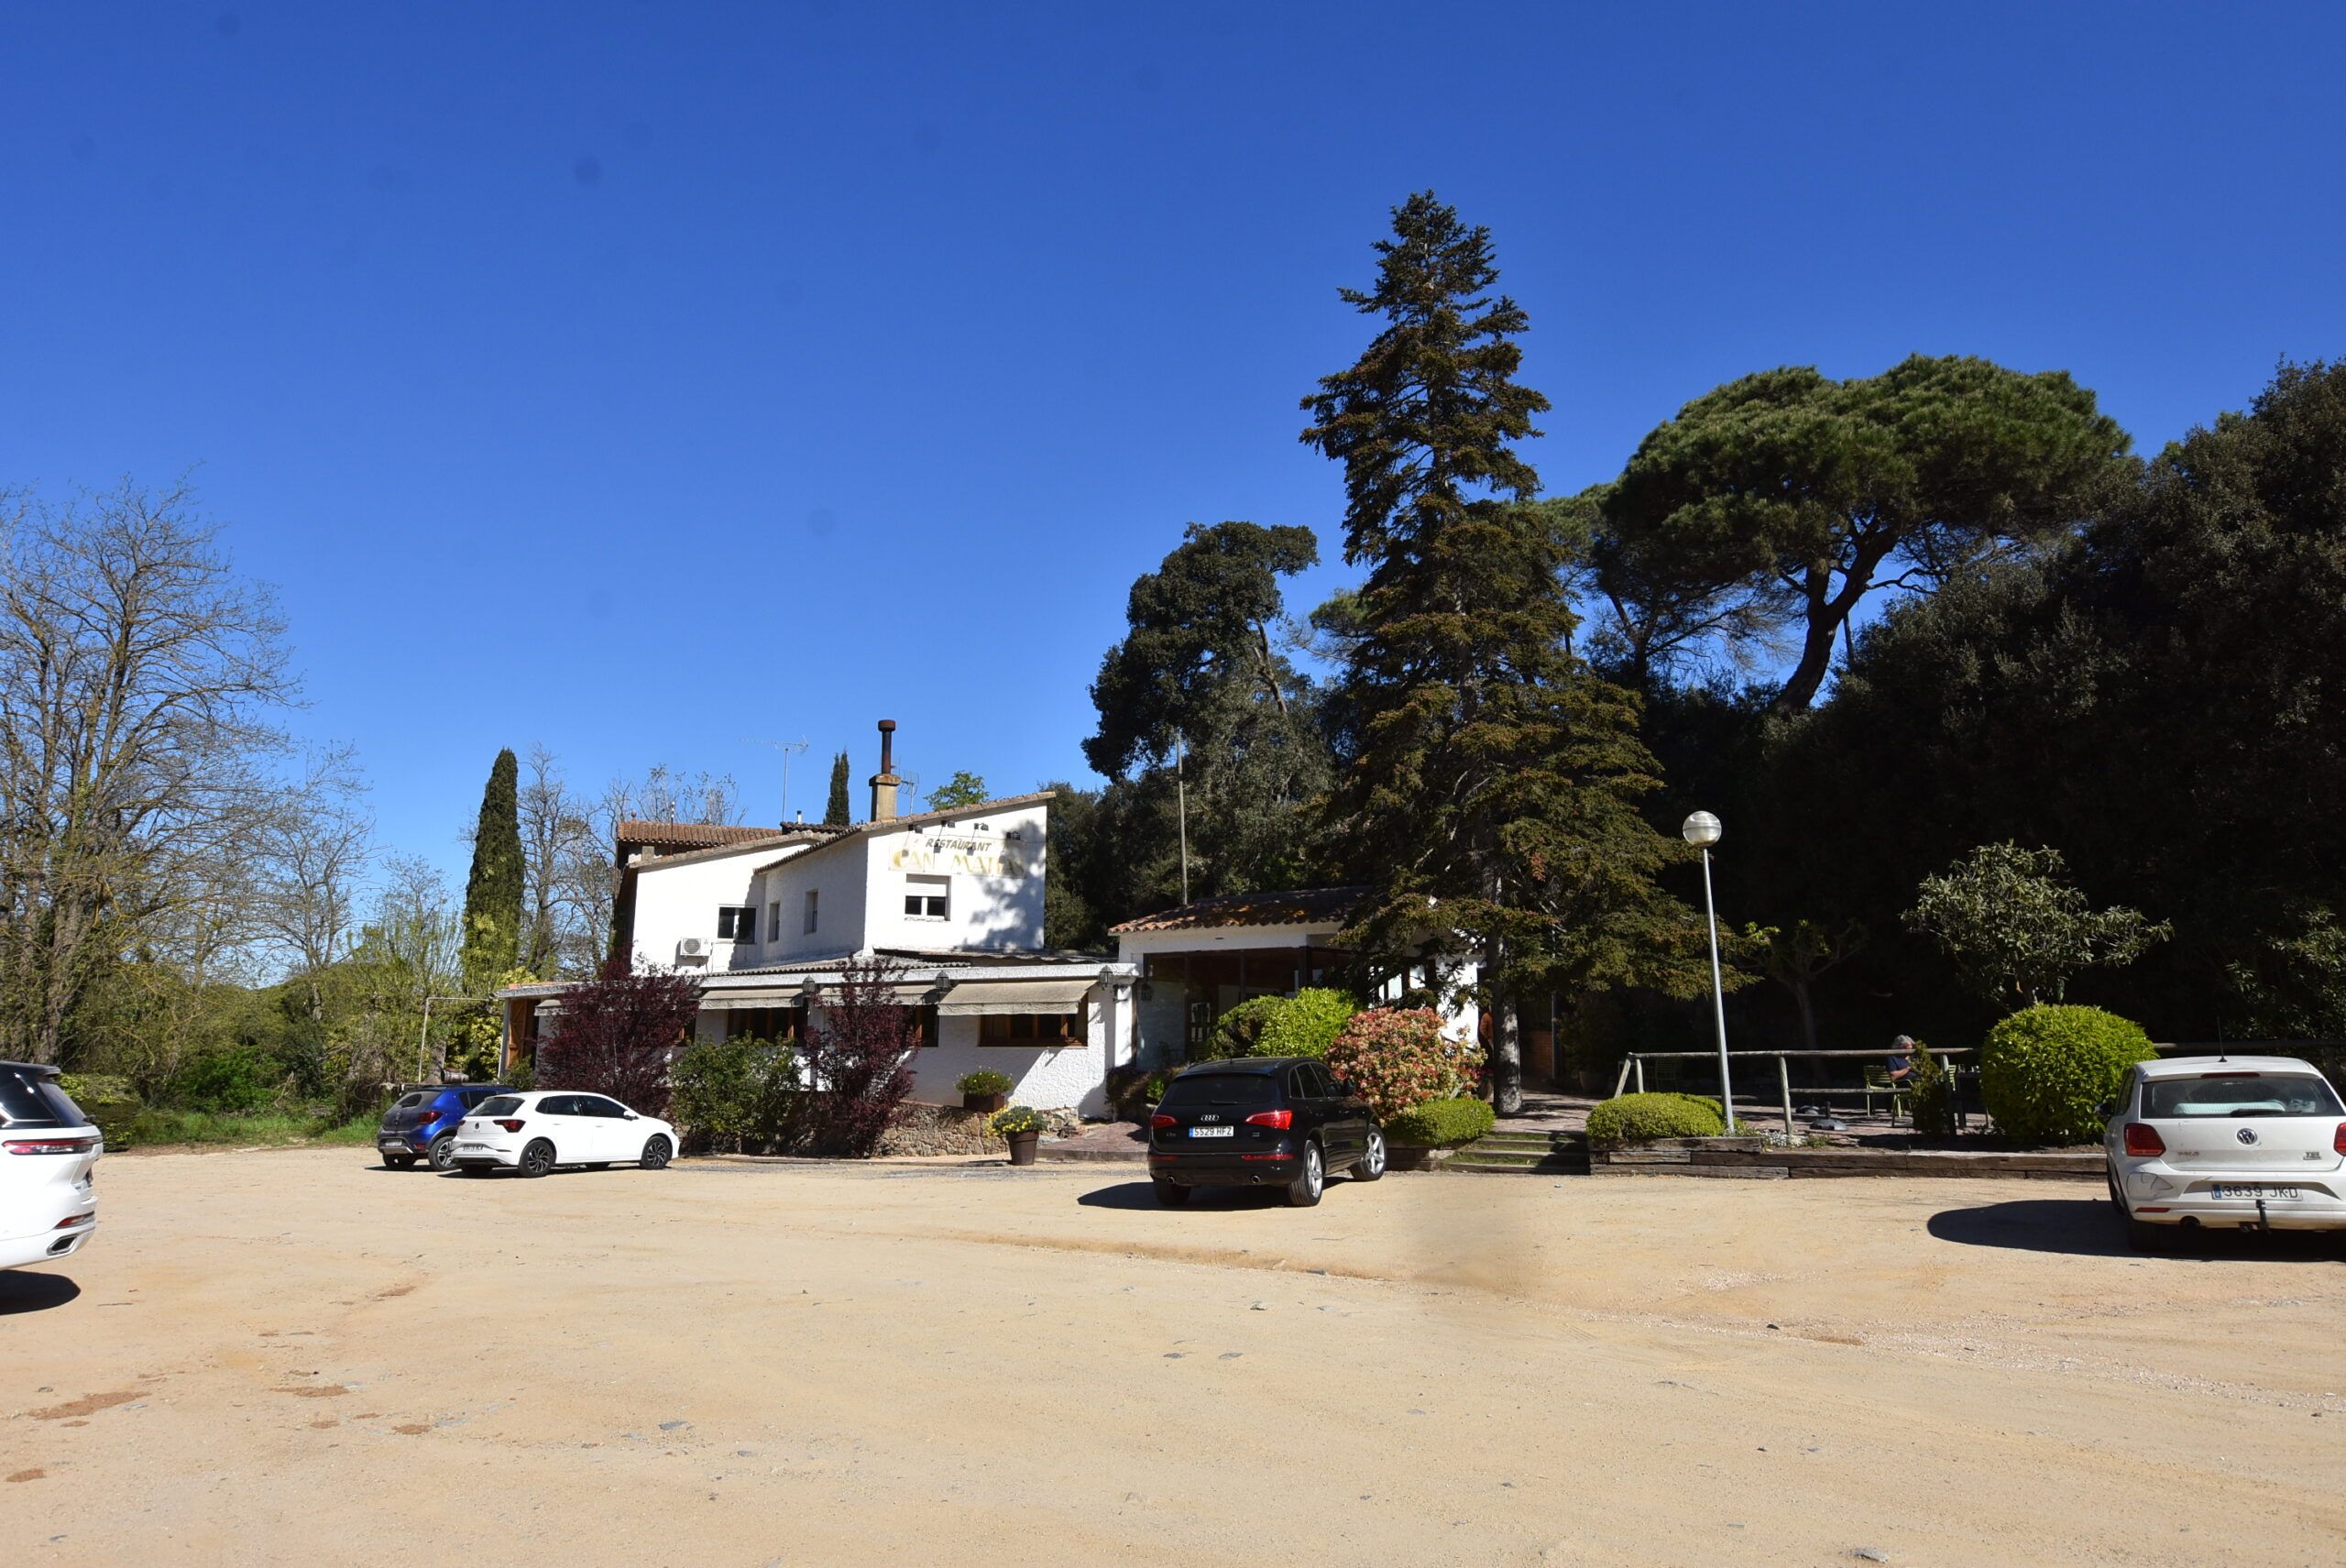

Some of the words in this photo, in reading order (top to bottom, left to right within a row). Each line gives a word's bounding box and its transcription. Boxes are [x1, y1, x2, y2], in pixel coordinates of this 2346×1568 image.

[893, 850, 935, 870] CAN
[1194, 1127, 1215, 1136] 5529
[1216, 1126, 1233, 1135] HFZ
[2222, 1185, 2264, 1198] 3639
[2269, 1186, 2299, 1199] JKD
